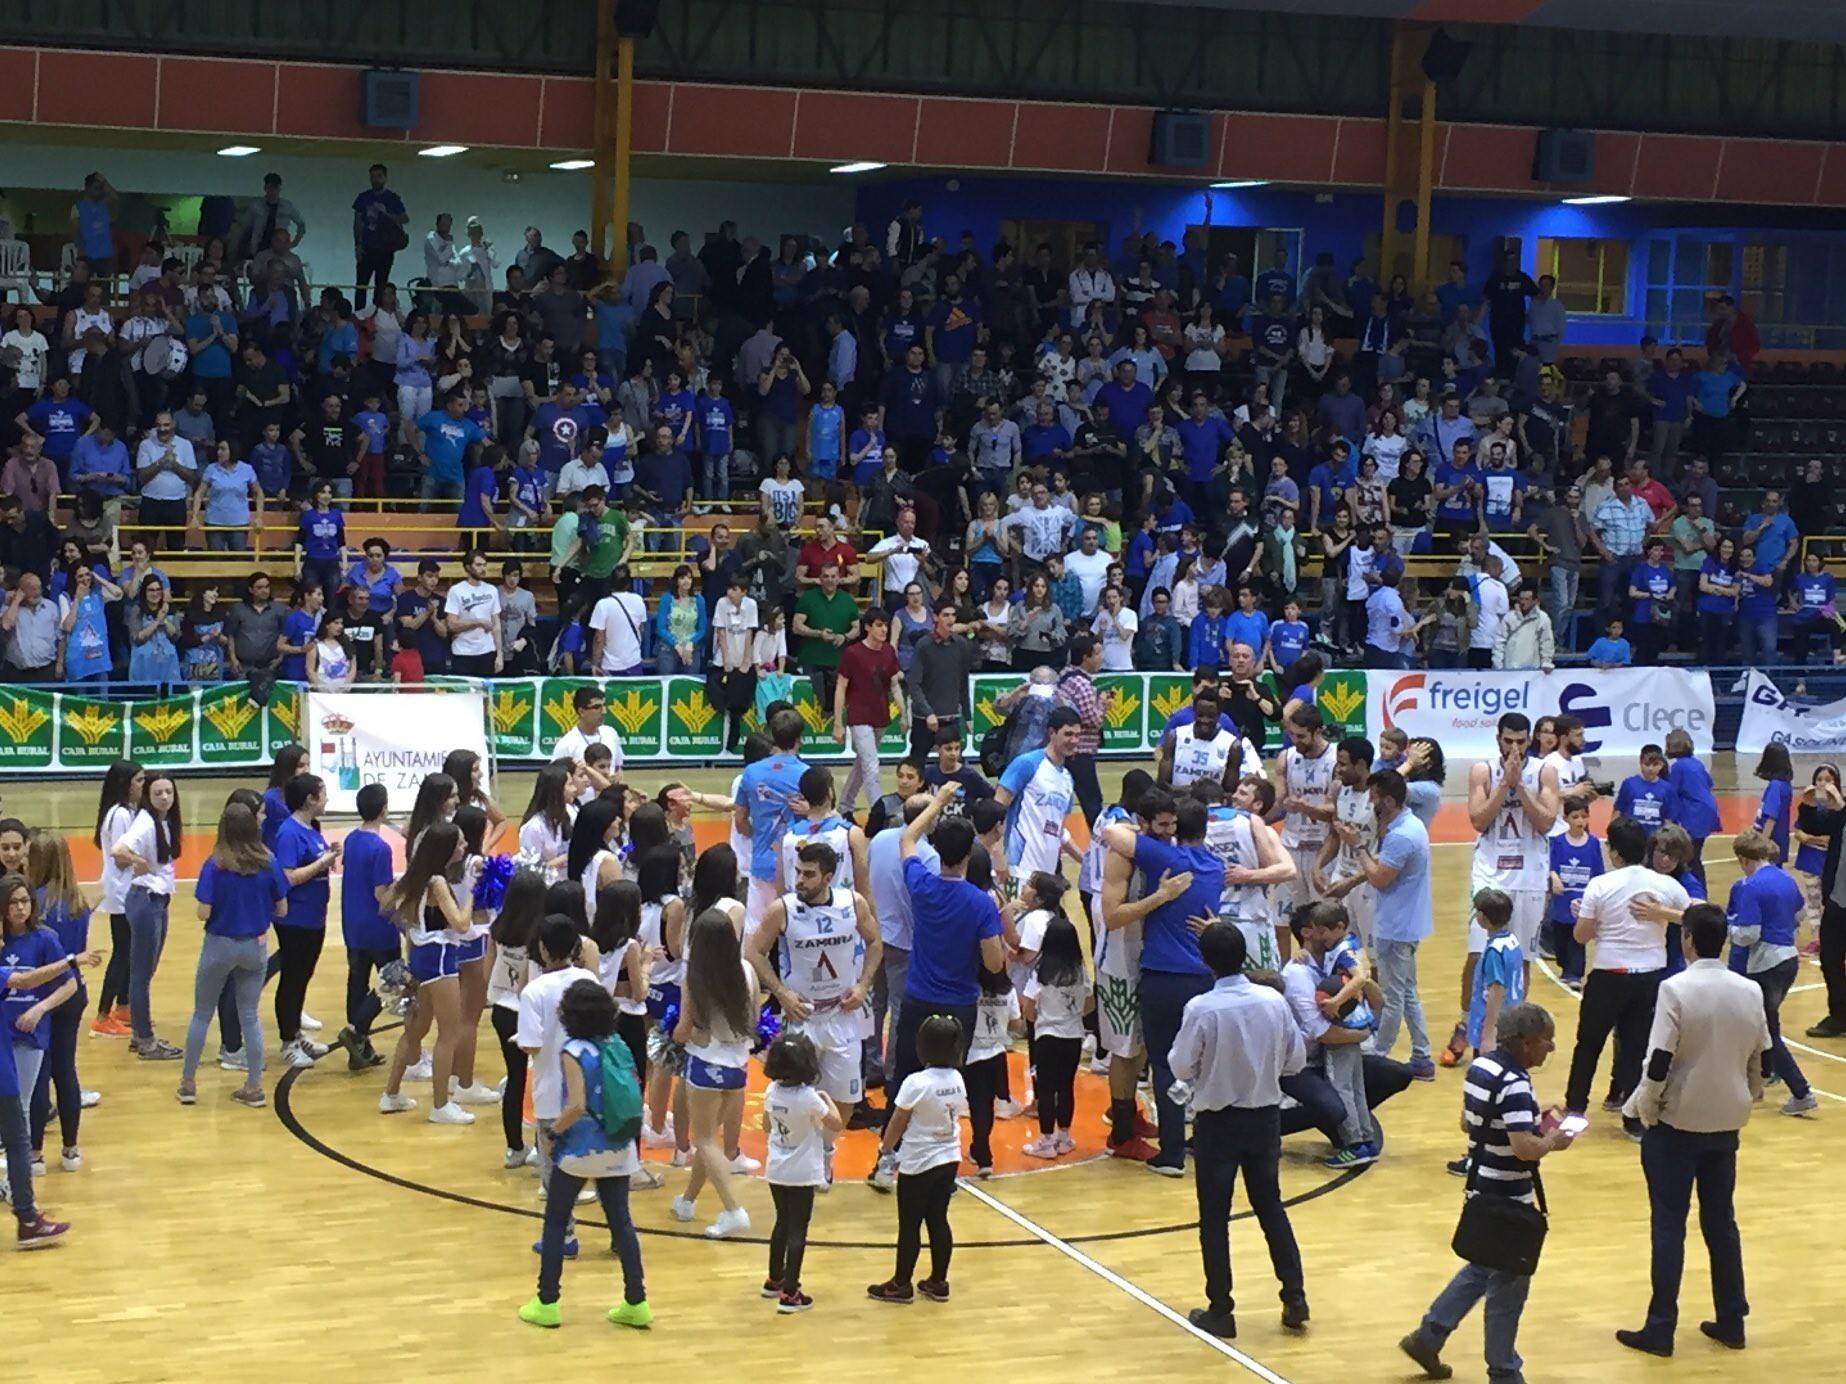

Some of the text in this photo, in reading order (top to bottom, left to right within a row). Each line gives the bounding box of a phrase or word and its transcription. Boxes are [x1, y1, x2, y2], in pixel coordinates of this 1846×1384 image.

[1429, 681, 1529, 715] freigel
[1623, 702, 1705, 732] Clece
[202, 740, 260, 752] CAJA RURAL
[363, 750, 448, 768] AYUNTAMIE
[815, 915, 834, 934] 12
[794, 934, 853, 949] ZAMORA
